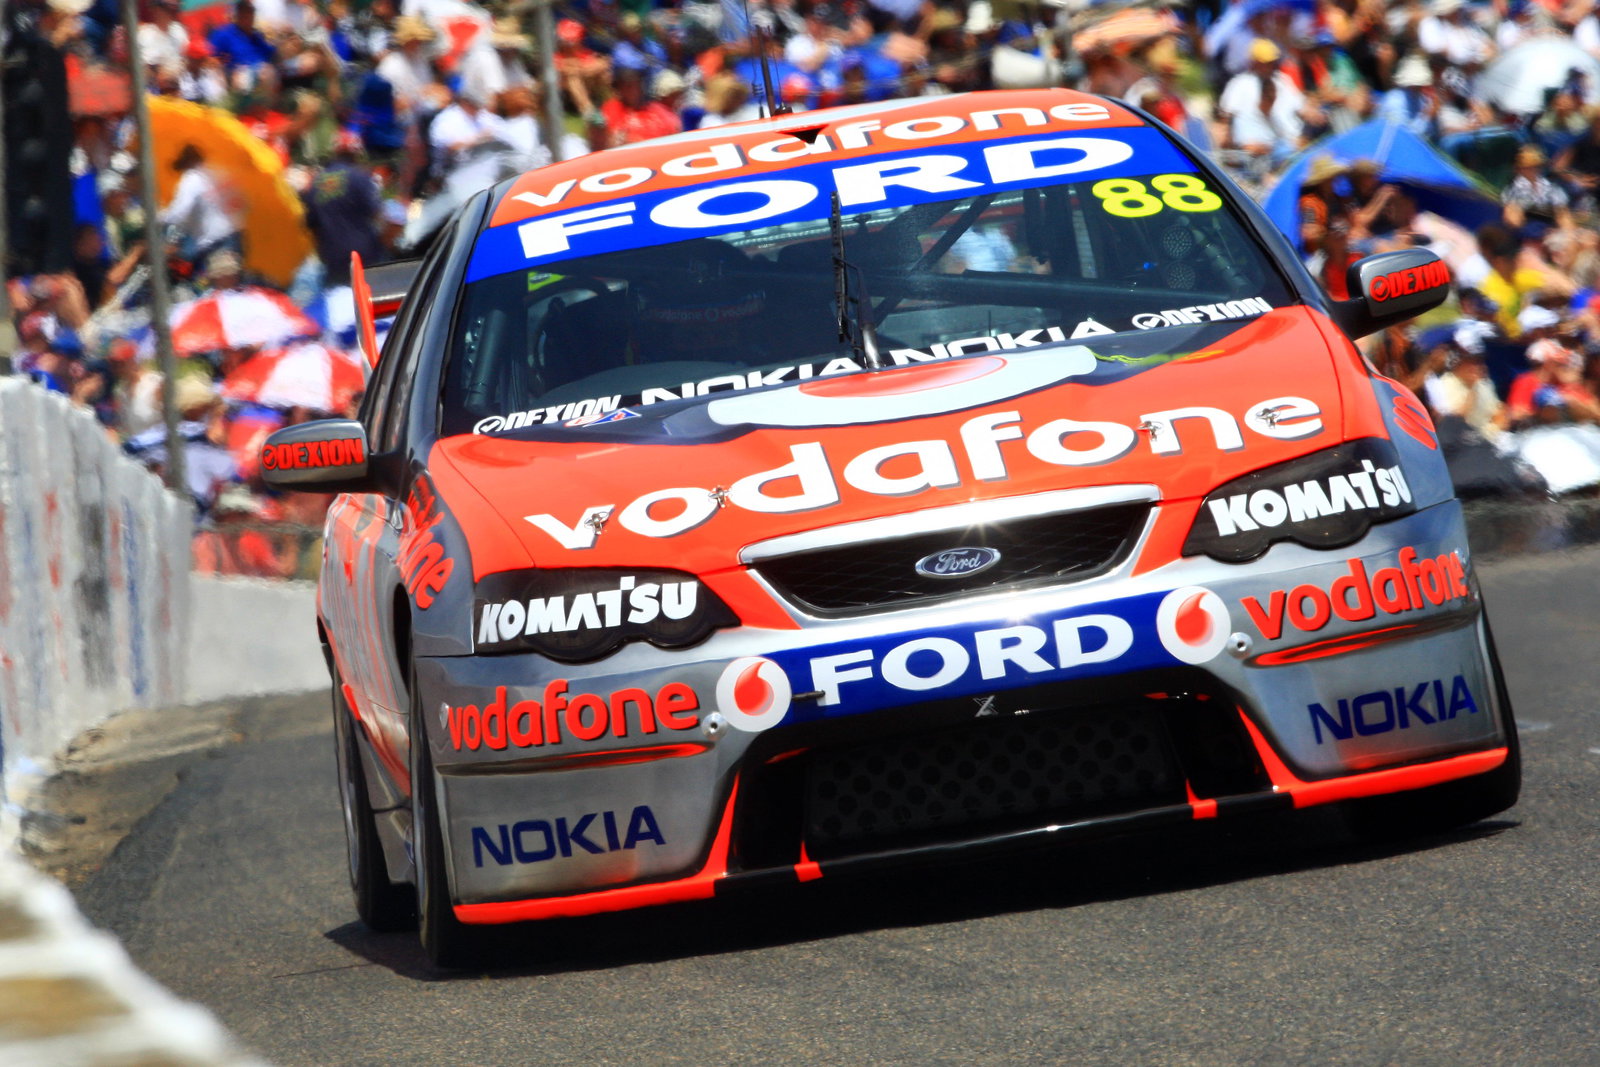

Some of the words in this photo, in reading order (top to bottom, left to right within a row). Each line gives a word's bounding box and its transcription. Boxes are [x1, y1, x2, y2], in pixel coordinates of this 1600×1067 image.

[512, 103, 1110, 207] vodafone
[519, 138, 1134, 259] FORD
[1092, 174, 1222, 218] 88
[1386, 260, 1450, 298] DEXION
[889, 320, 1116, 365] NOKIA
[641, 357, 863, 405] NOKIA
[277, 438, 364, 470] DEXION
[524, 397, 1323, 549] vodafone
[1208, 459, 1412, 537] KOMATSU
[935, 550, 981, 573] Ford
[1240, 546, 1468, 640] vodafone
[477, 576, 698, 645] KOMATSU
[810, 614, 1134, 707] FORD
[446, 680, 698, 751] vodafone
[1307, 675, 1478, 746] NOKIA
[472, 805, 666, 868] NOKIA
